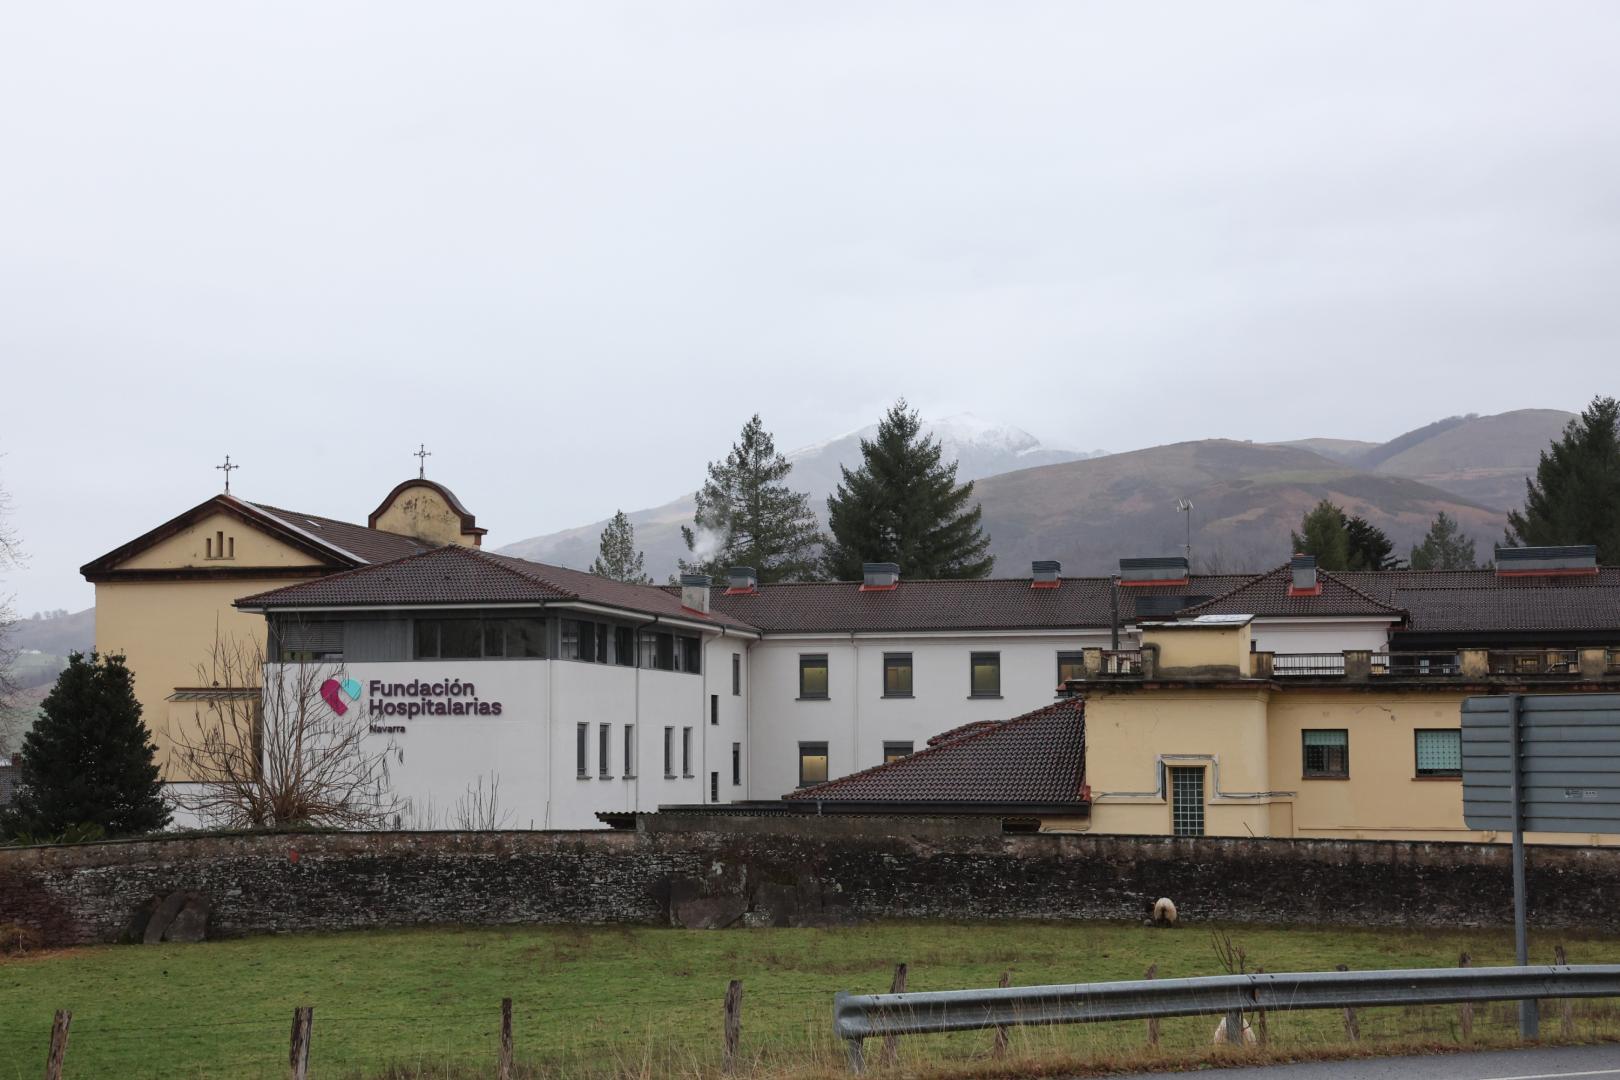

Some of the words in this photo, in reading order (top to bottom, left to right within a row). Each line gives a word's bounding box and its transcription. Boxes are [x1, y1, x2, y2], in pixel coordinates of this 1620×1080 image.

[369, 678, 475, 697] Fundación
[369, 697, 502, 719] Hospitalarias
[369, 725, 406, 734] Navarra
